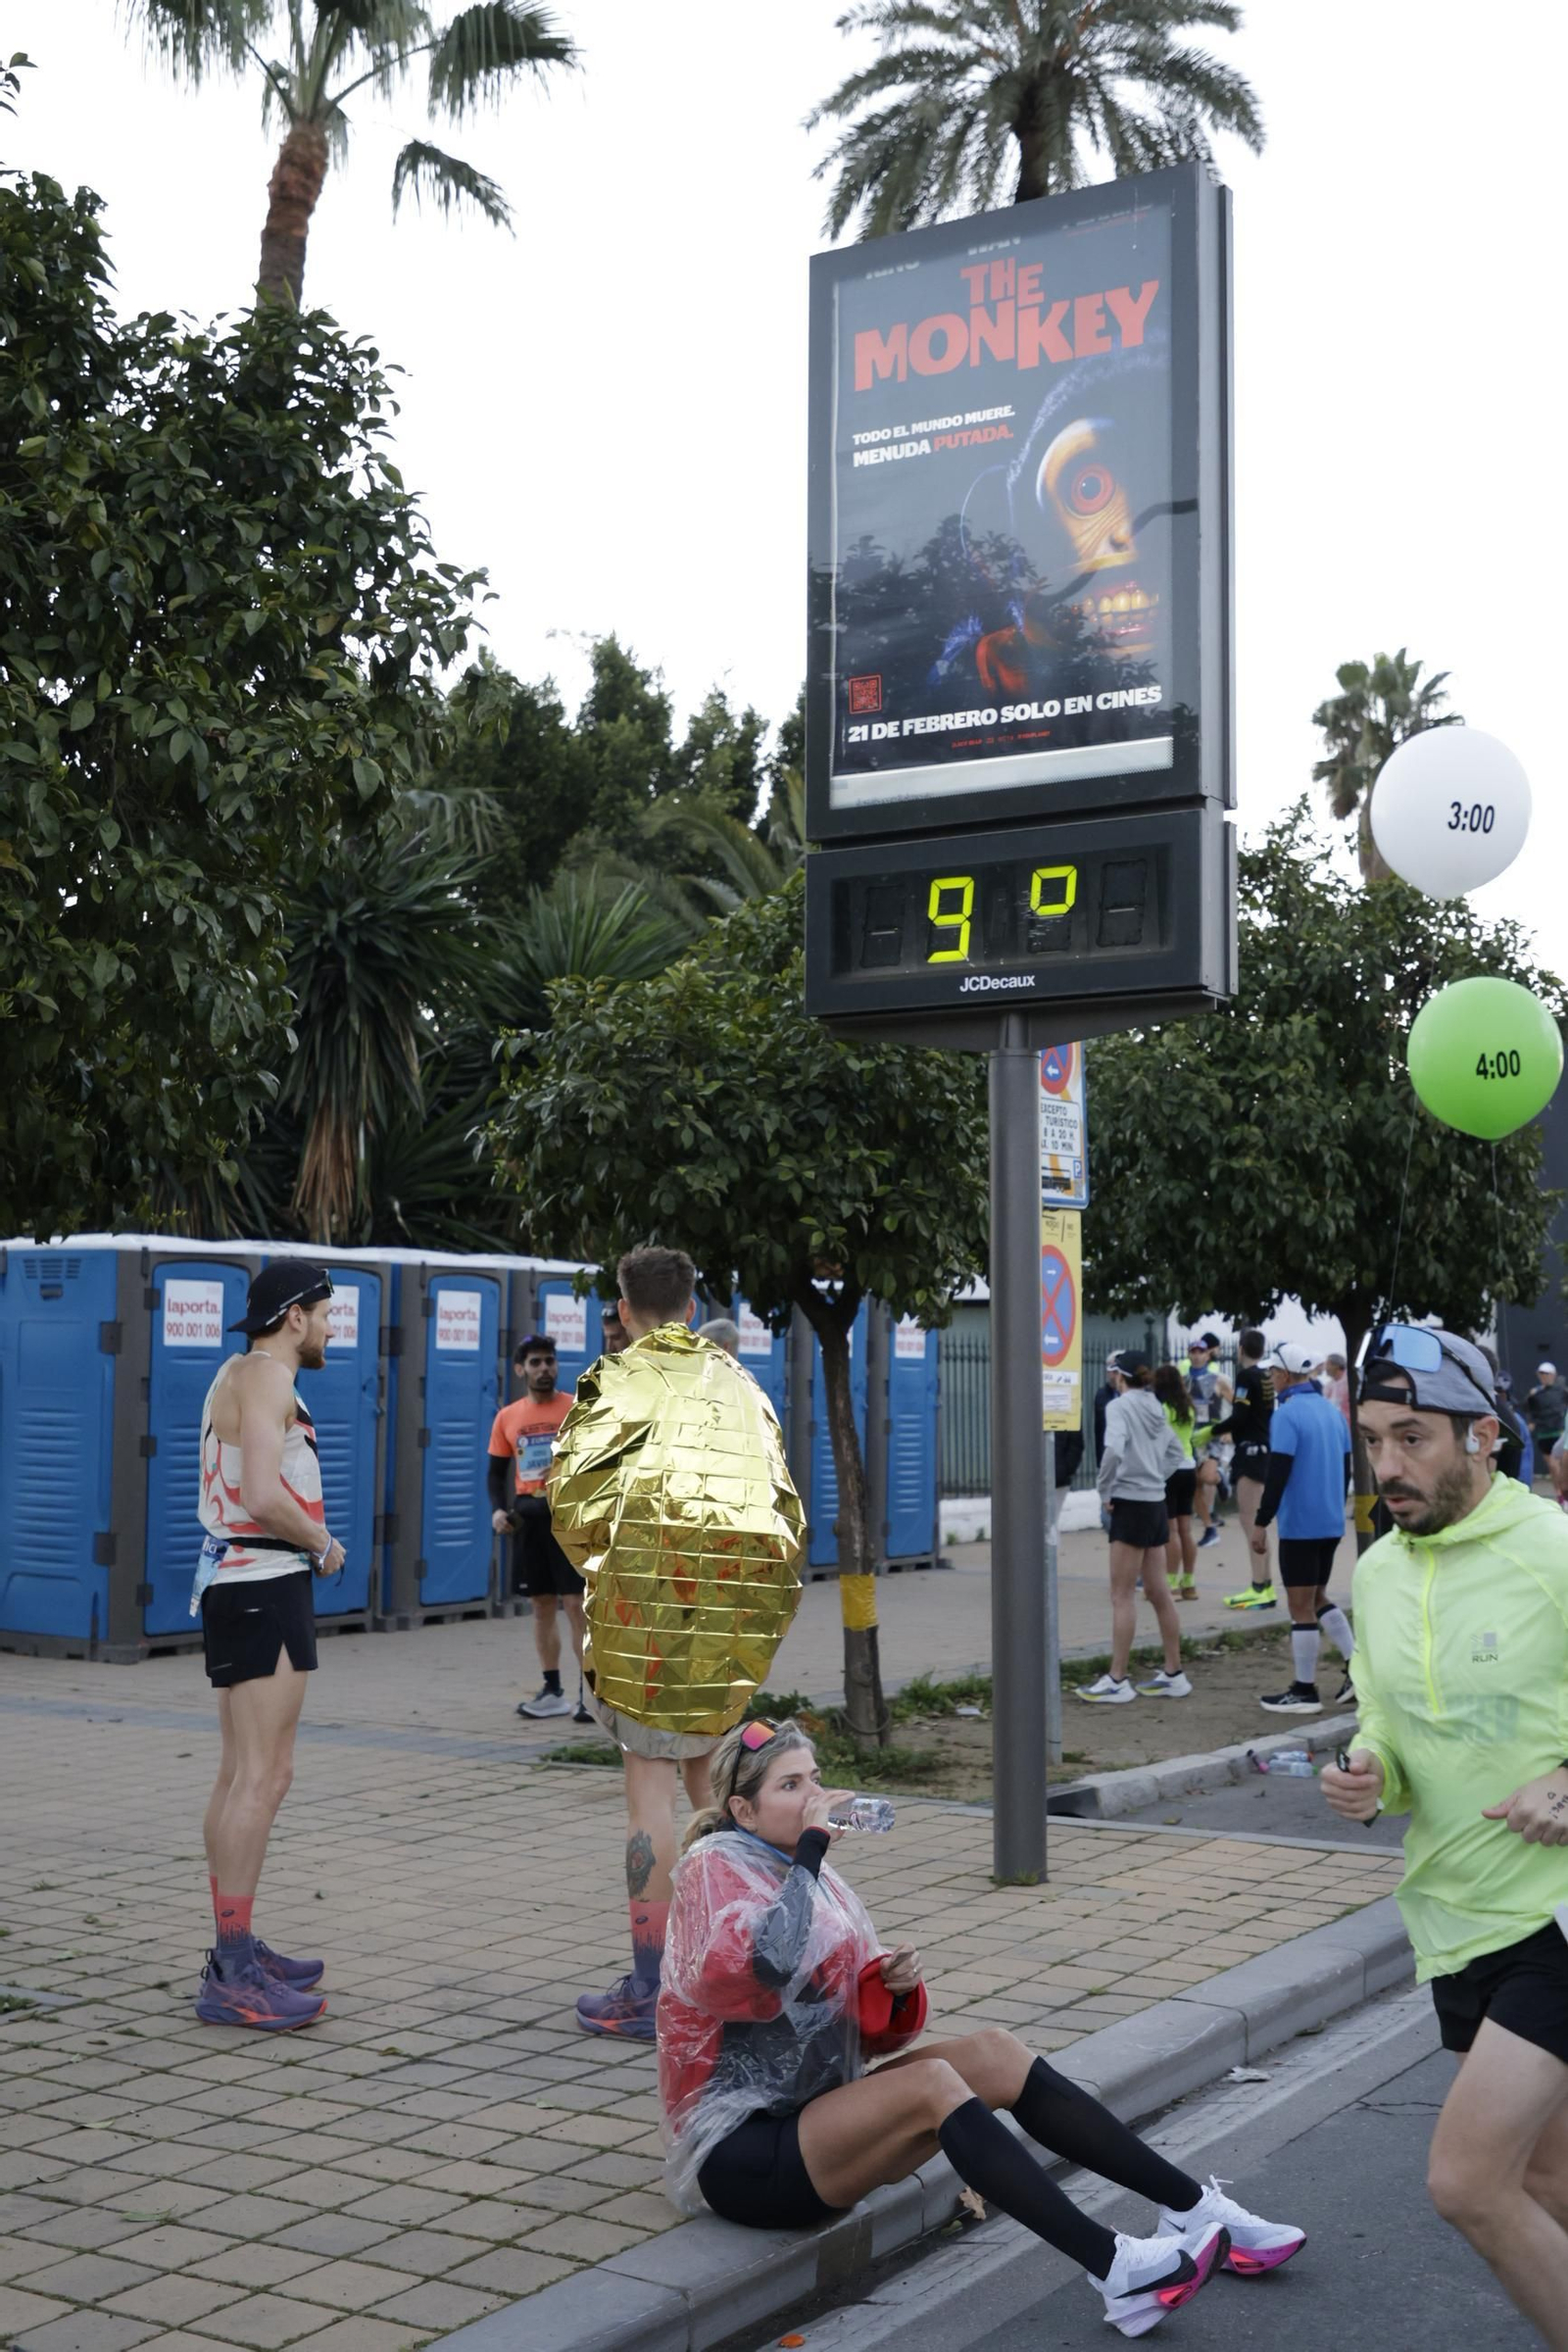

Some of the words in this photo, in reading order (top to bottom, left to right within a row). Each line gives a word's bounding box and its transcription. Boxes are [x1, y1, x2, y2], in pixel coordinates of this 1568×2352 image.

[960, 258, 1044, 307] THE
[855, 280, 1159, 391] MONKEY
[853, 427, 891, 445] TODO
[893, 425, 909, 439] EL
[911, 415, 962, 436] MUNDO
[964, 405, 1015, 426] MUERE.
[853, 438, 931, 467] MENUDA
[934, 423, 1013, 452] PUTADA.
[848, 725, 868, 743] 21
[871, 720, 900, 741] DE
[903, 709, 999, 736] FEBRERO
[1001, 699, 1060, 724] SOLO
[1063, 695, 1093, 715] EN
[1096, 685, 1162, 710] CINES
[1447, 801, 1495, 834] 3:00
[959, 973, 1035, 993] JCDecaux
[1475, 1050, 1521, 1080] 4:00
[1058, 1129, 1067, 1140] 20
[168, 1298, 220, 1316] laporta.
[167, 1322, 184, 1337] 900
[186, 1323, 203, 1338] 001
[1472, 1653, 1498, 1664] RUN
